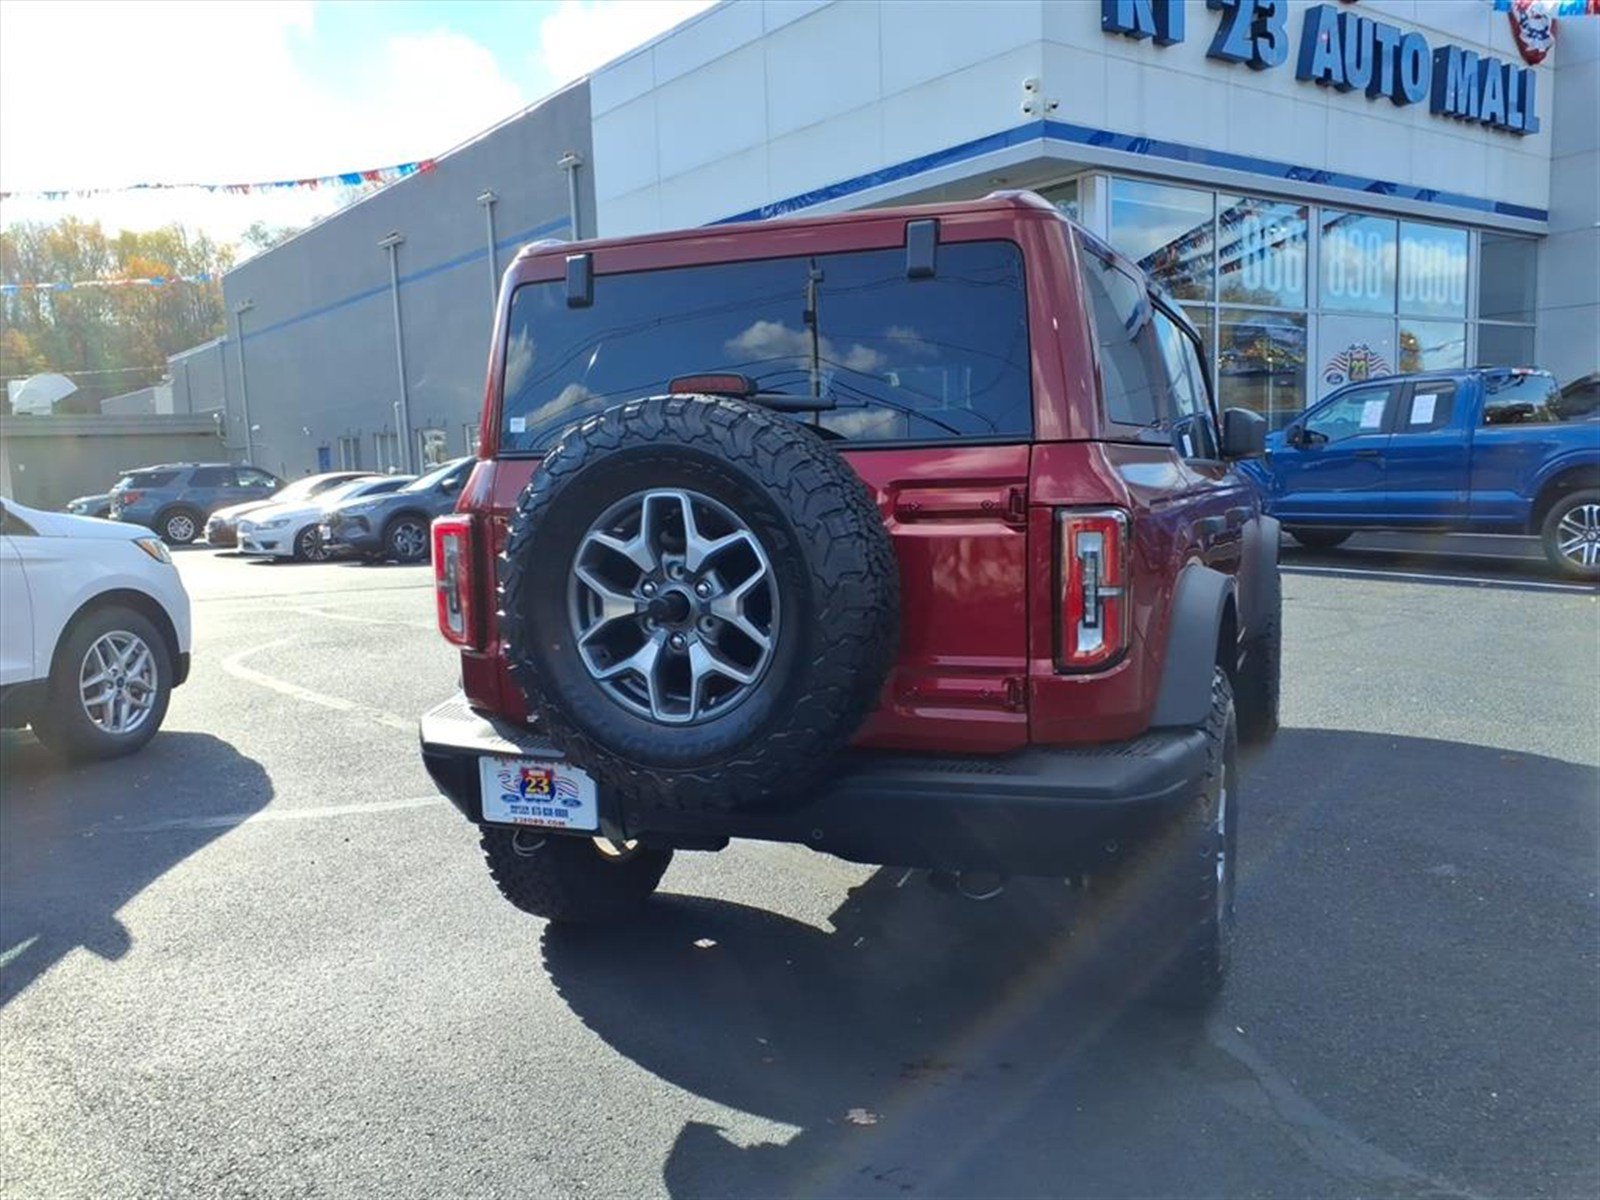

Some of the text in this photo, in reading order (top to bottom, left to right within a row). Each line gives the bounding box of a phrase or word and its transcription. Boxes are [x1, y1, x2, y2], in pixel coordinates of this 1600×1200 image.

[1206, 0, 1289, 70] 23
[1297, 3, 1431, 107] AUTO
[1431, 44, 1540, 136] MALL
[525, 777, 550, 794] 23
